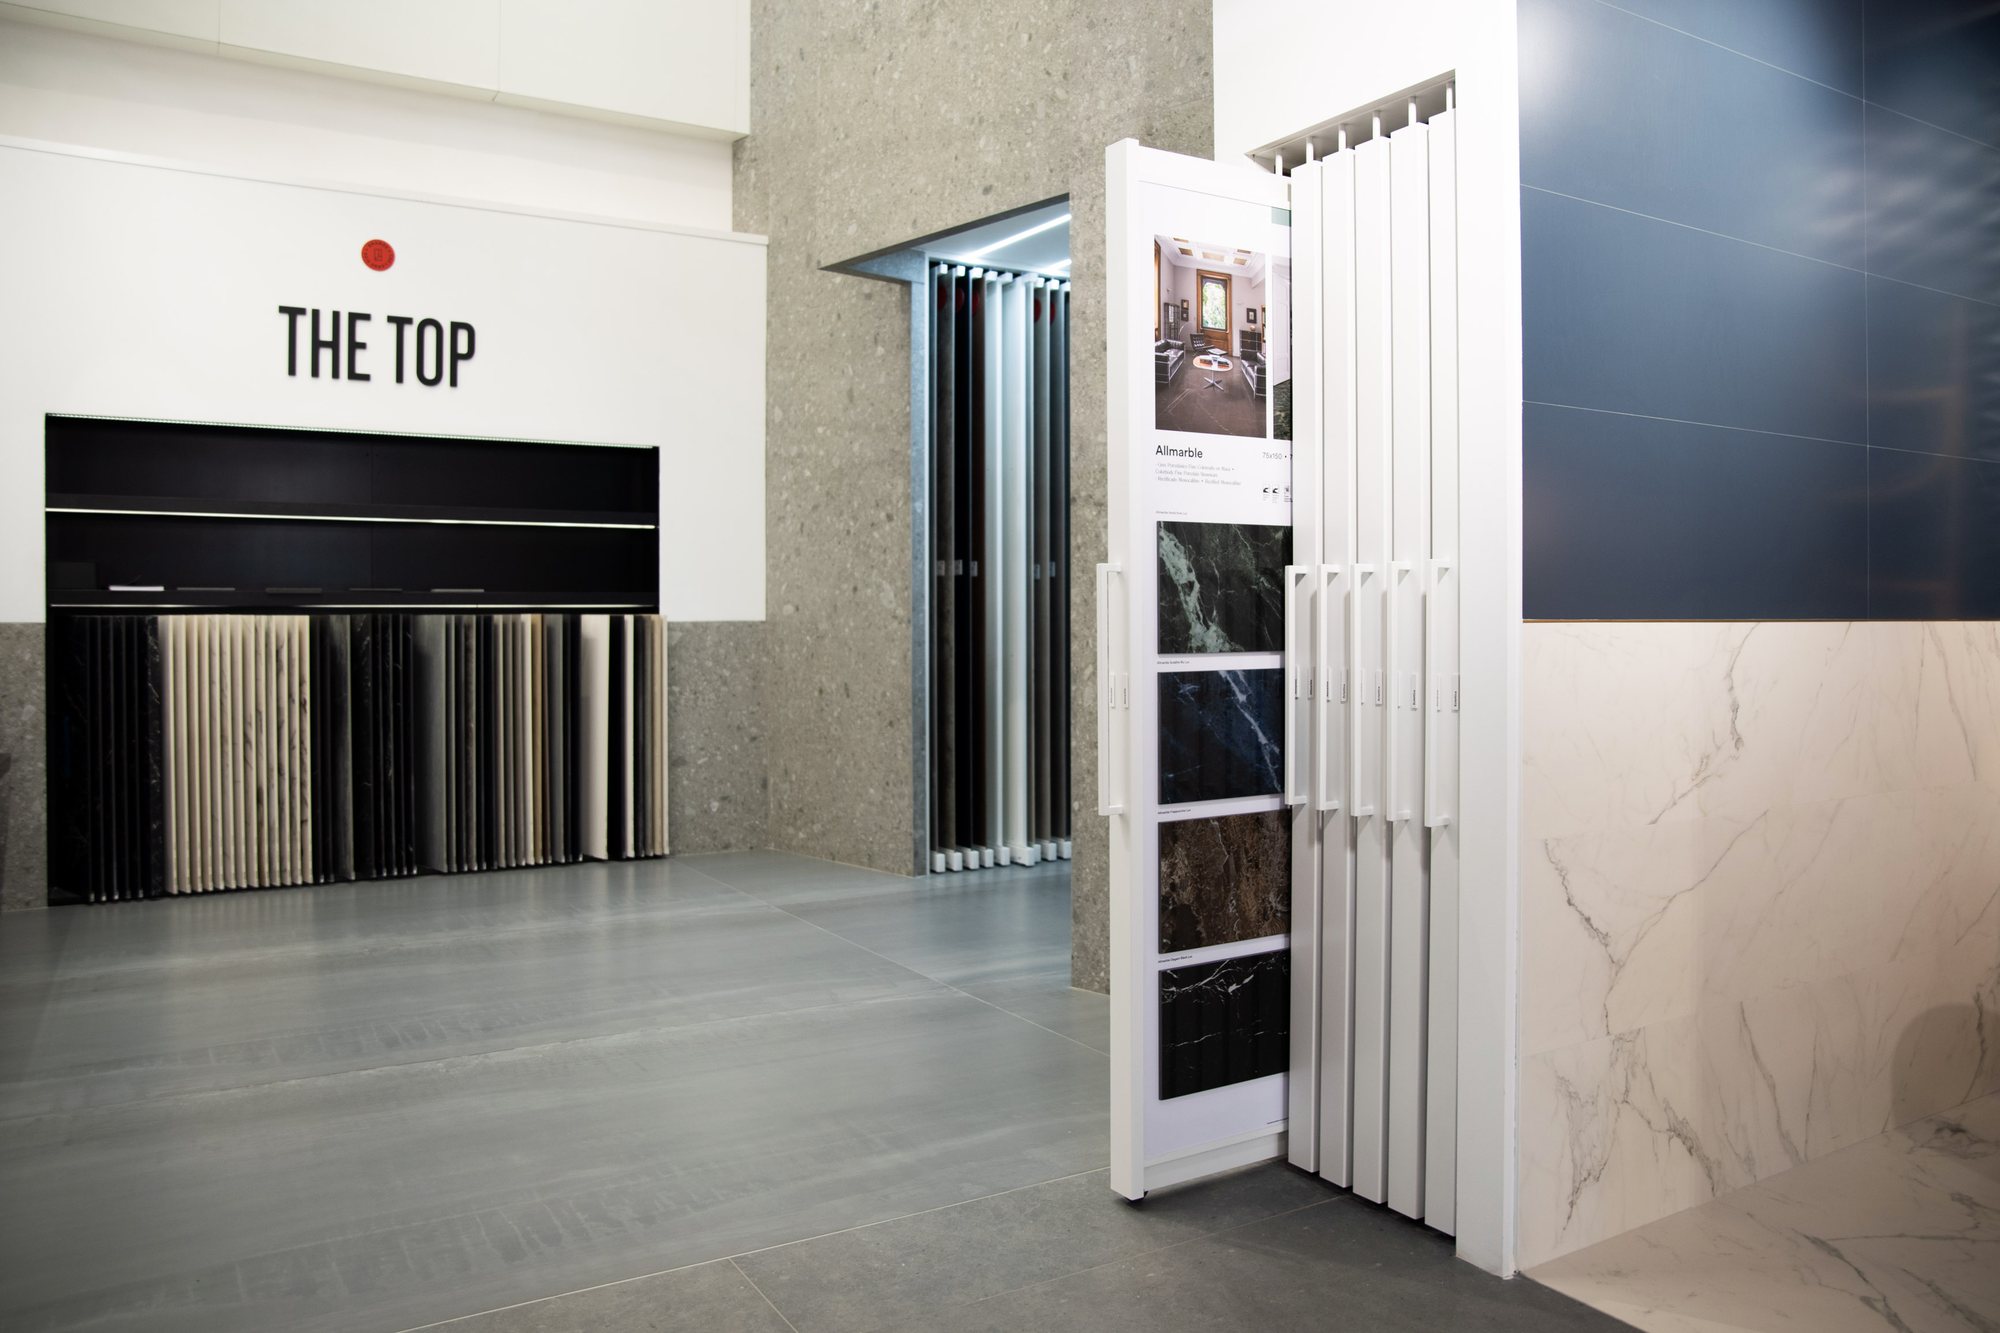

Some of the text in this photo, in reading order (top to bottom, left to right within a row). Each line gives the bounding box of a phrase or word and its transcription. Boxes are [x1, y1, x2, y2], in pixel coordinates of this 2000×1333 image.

[278, 305, 476, 388] THE TOP
[1155, 445, 1203, 458] Allmarble
